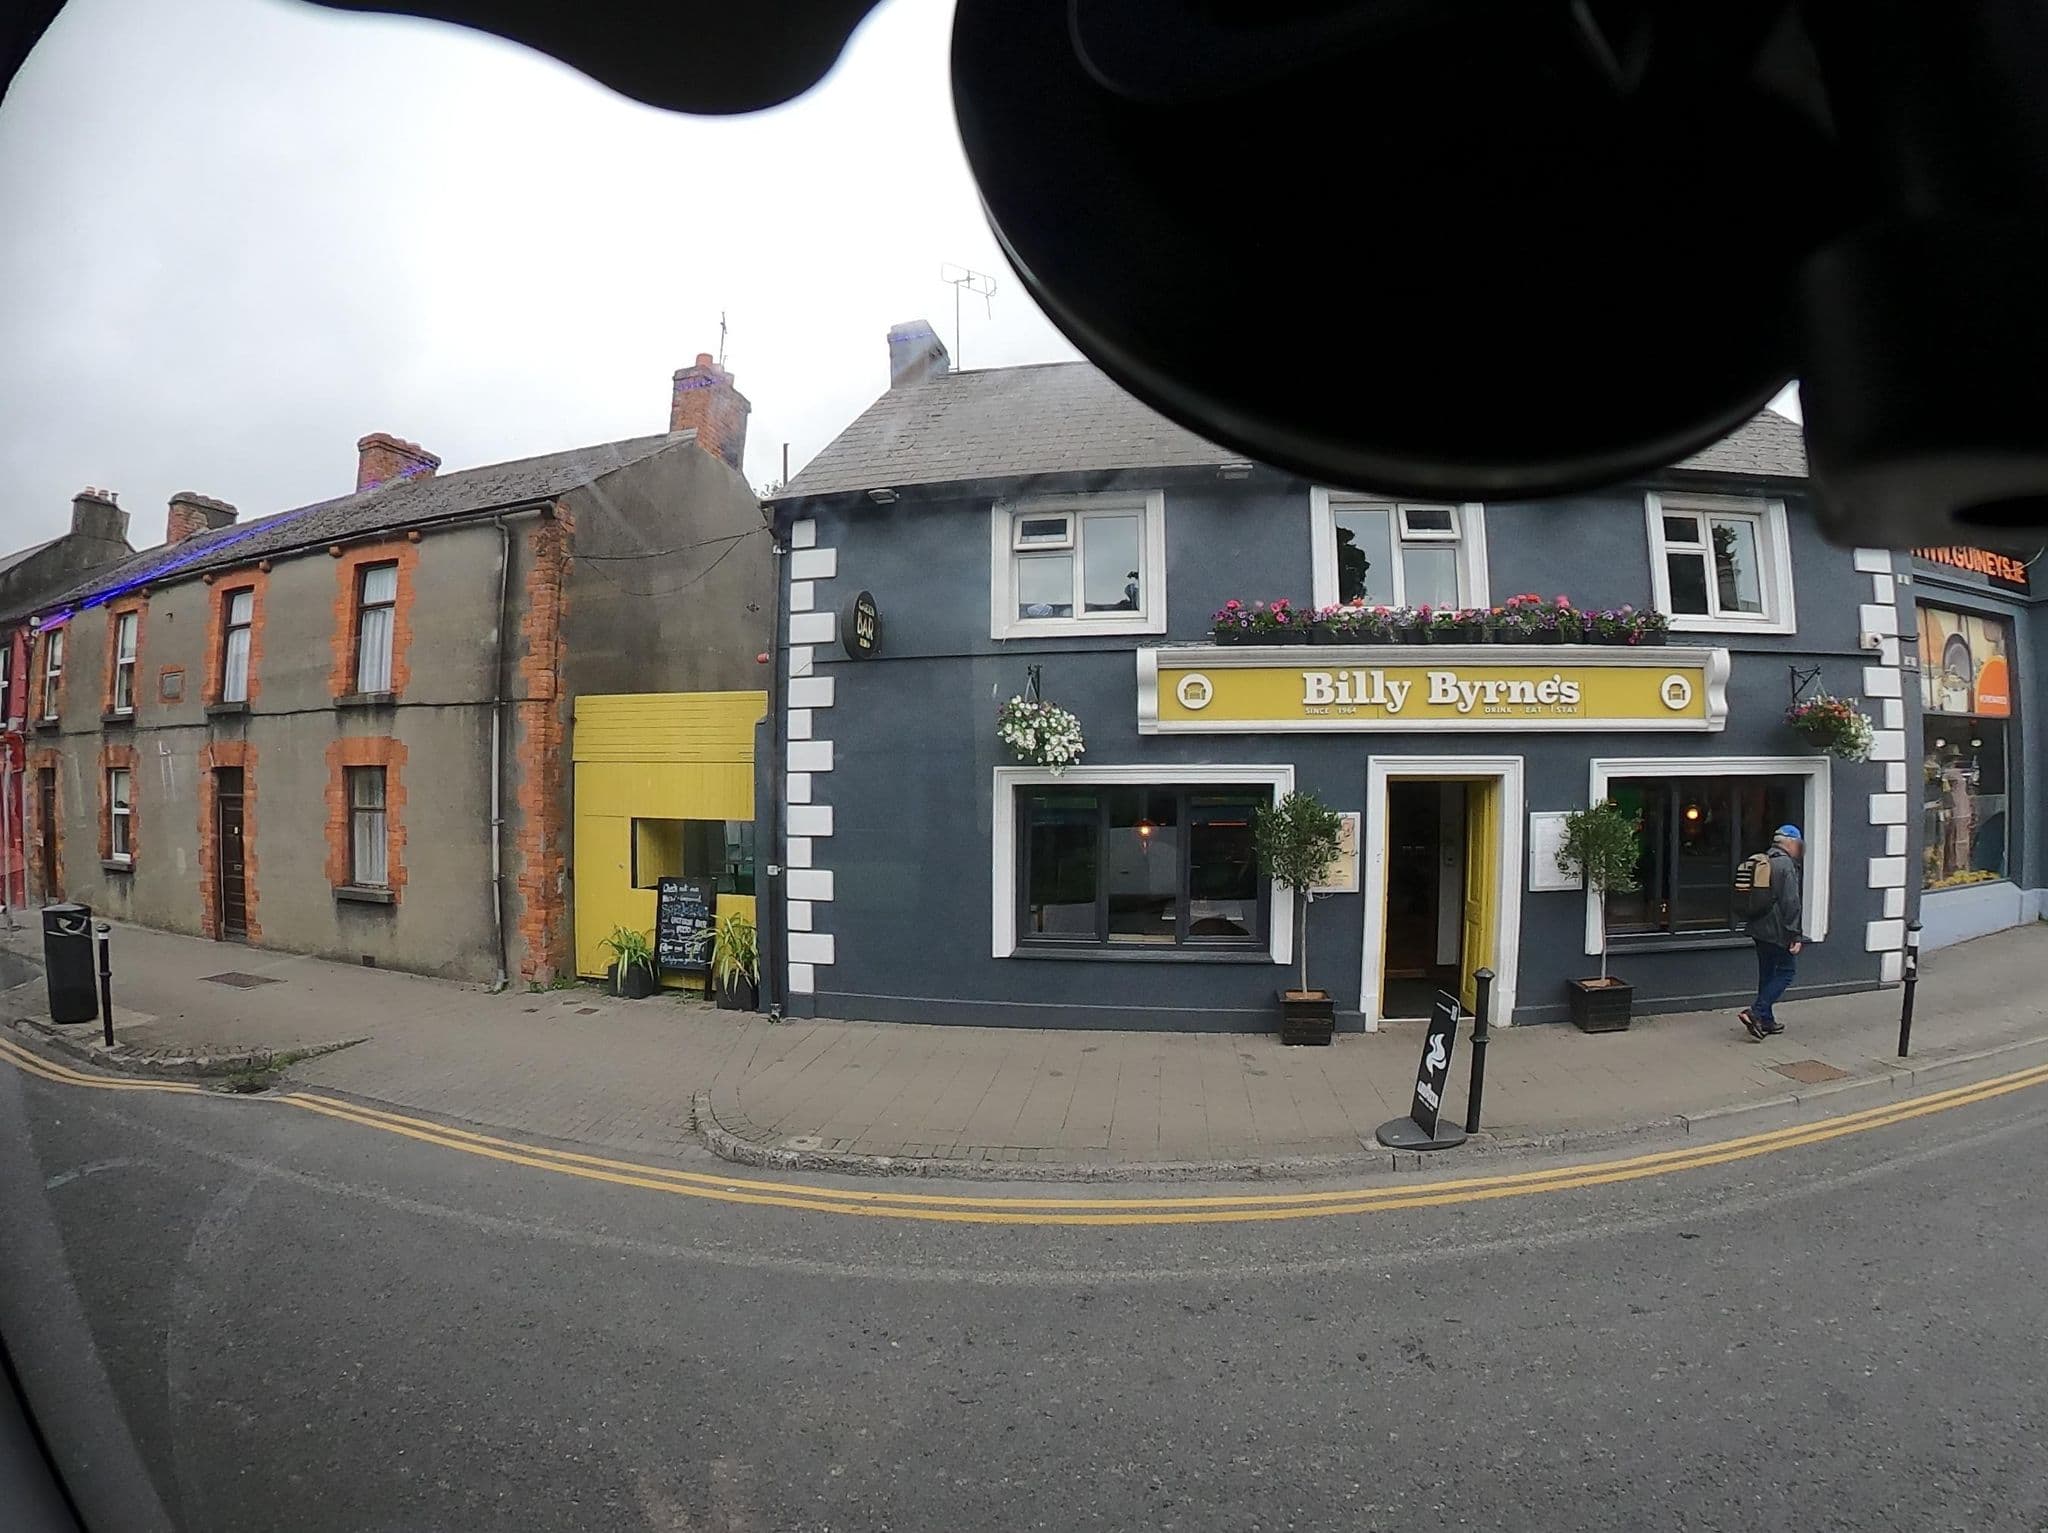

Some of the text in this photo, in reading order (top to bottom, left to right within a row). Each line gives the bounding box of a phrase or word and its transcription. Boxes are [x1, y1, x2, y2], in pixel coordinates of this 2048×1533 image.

[1302, 670, 1581, 713] Billy Byrne's
[1338, 706, 1357, 714] 1964
